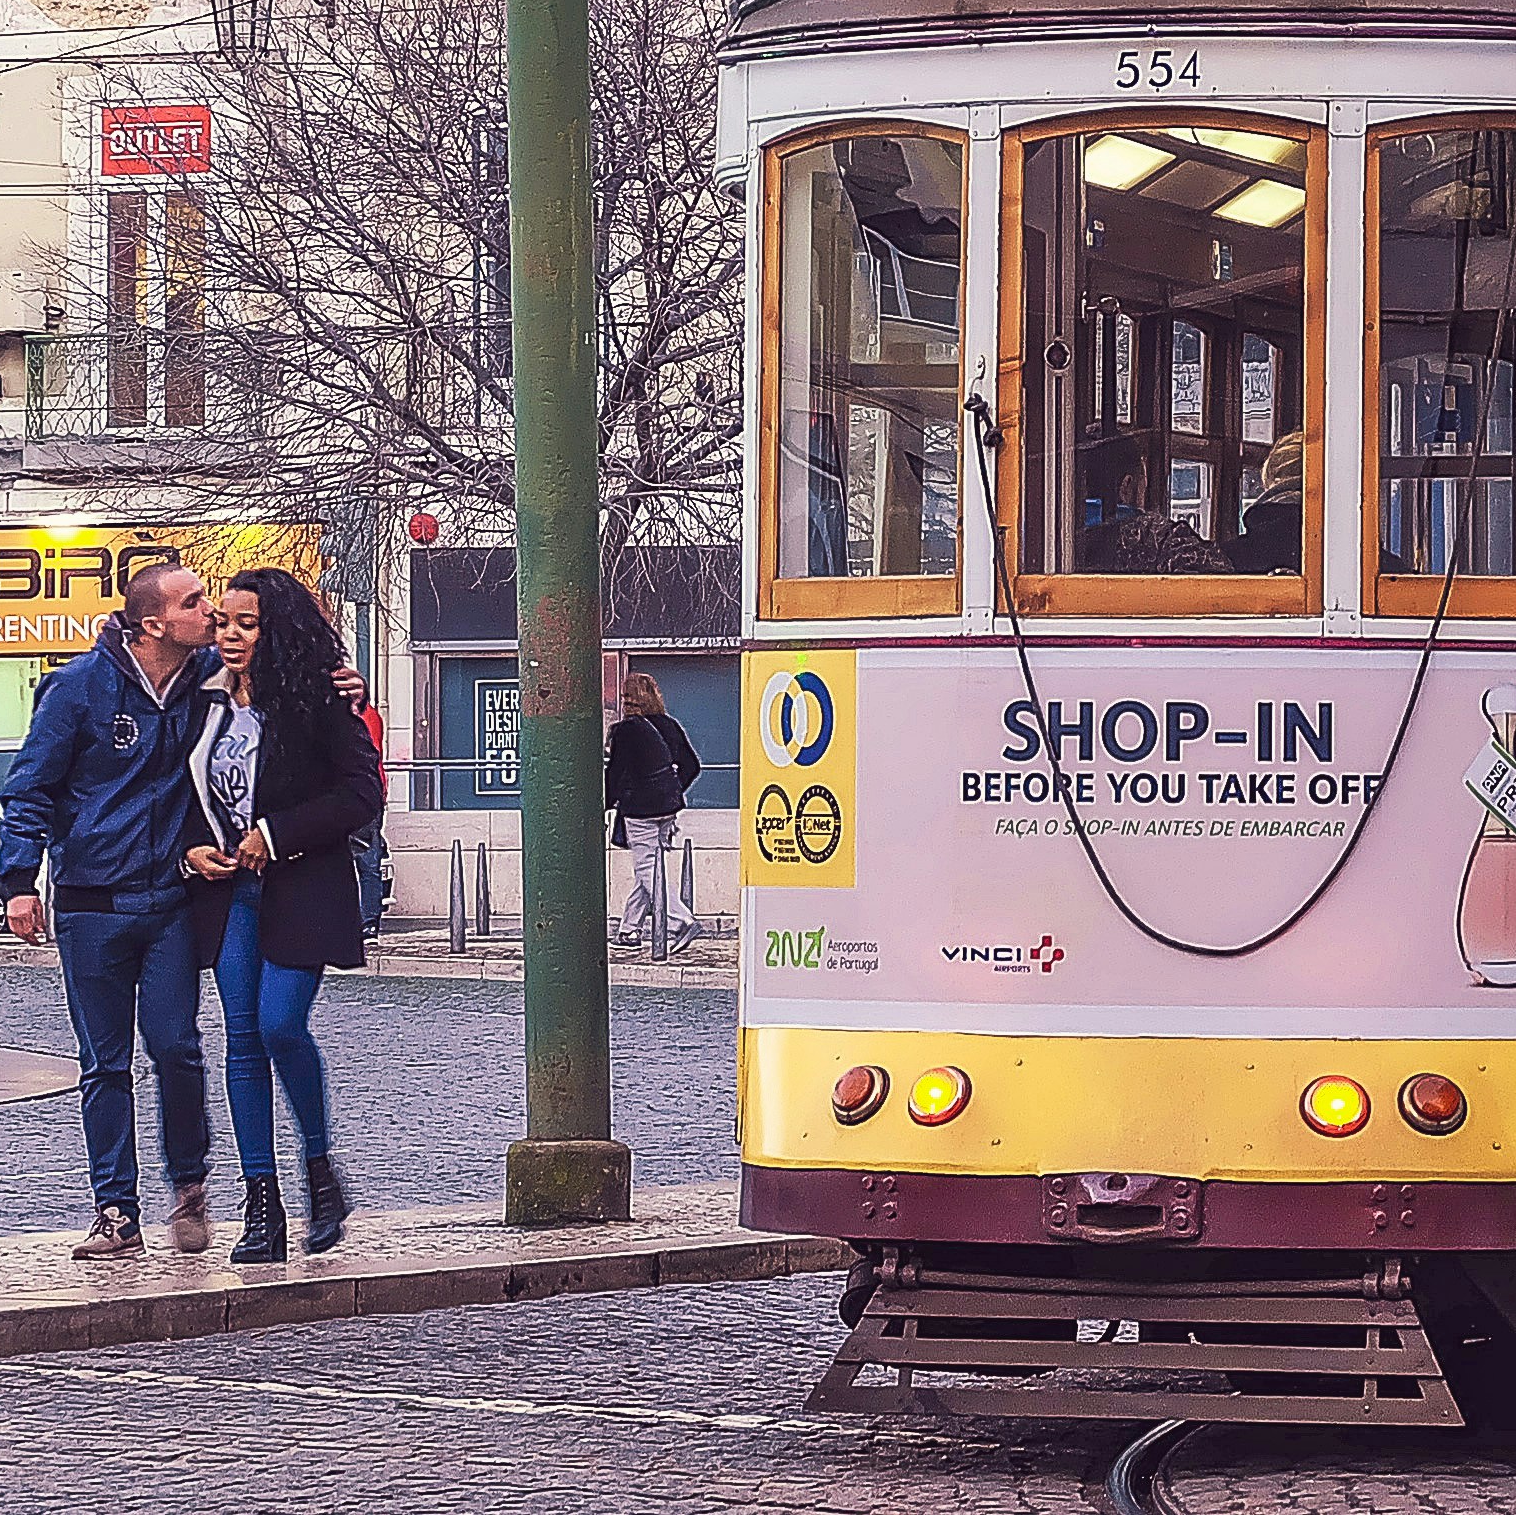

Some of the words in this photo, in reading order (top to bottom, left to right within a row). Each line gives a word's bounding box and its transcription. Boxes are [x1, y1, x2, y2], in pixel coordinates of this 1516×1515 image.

[1115, 49, 1201, 90] 554
[109, 128, 203, 154] OUTLET
[1002, 700, 1334, 763] SHOP-IN
[962, 772, 1095, 804] BEFORE
[1106, 773, 1186, 804] YOU
[1198, 773, 1296, 805] TAKE
[1308, 773, 1385, 805] OFF
[995, 818, 1039, 838] FAÇA
[1044, 819, 1059, 836] O
[1063, 819, 1141, 837] SHOP-IN
[1144, 820, 1204, 837] ANTES
[1209, 820, 1234, 837] DE
[1240, 820, 1346, 838] EMBARCAR
[827, 939, 878, 954] Aeroportos
[941, 946, 1022, 962] VINCI
[826, 955, 838, 970] de
[840, 957, 879, 974] Portugal
